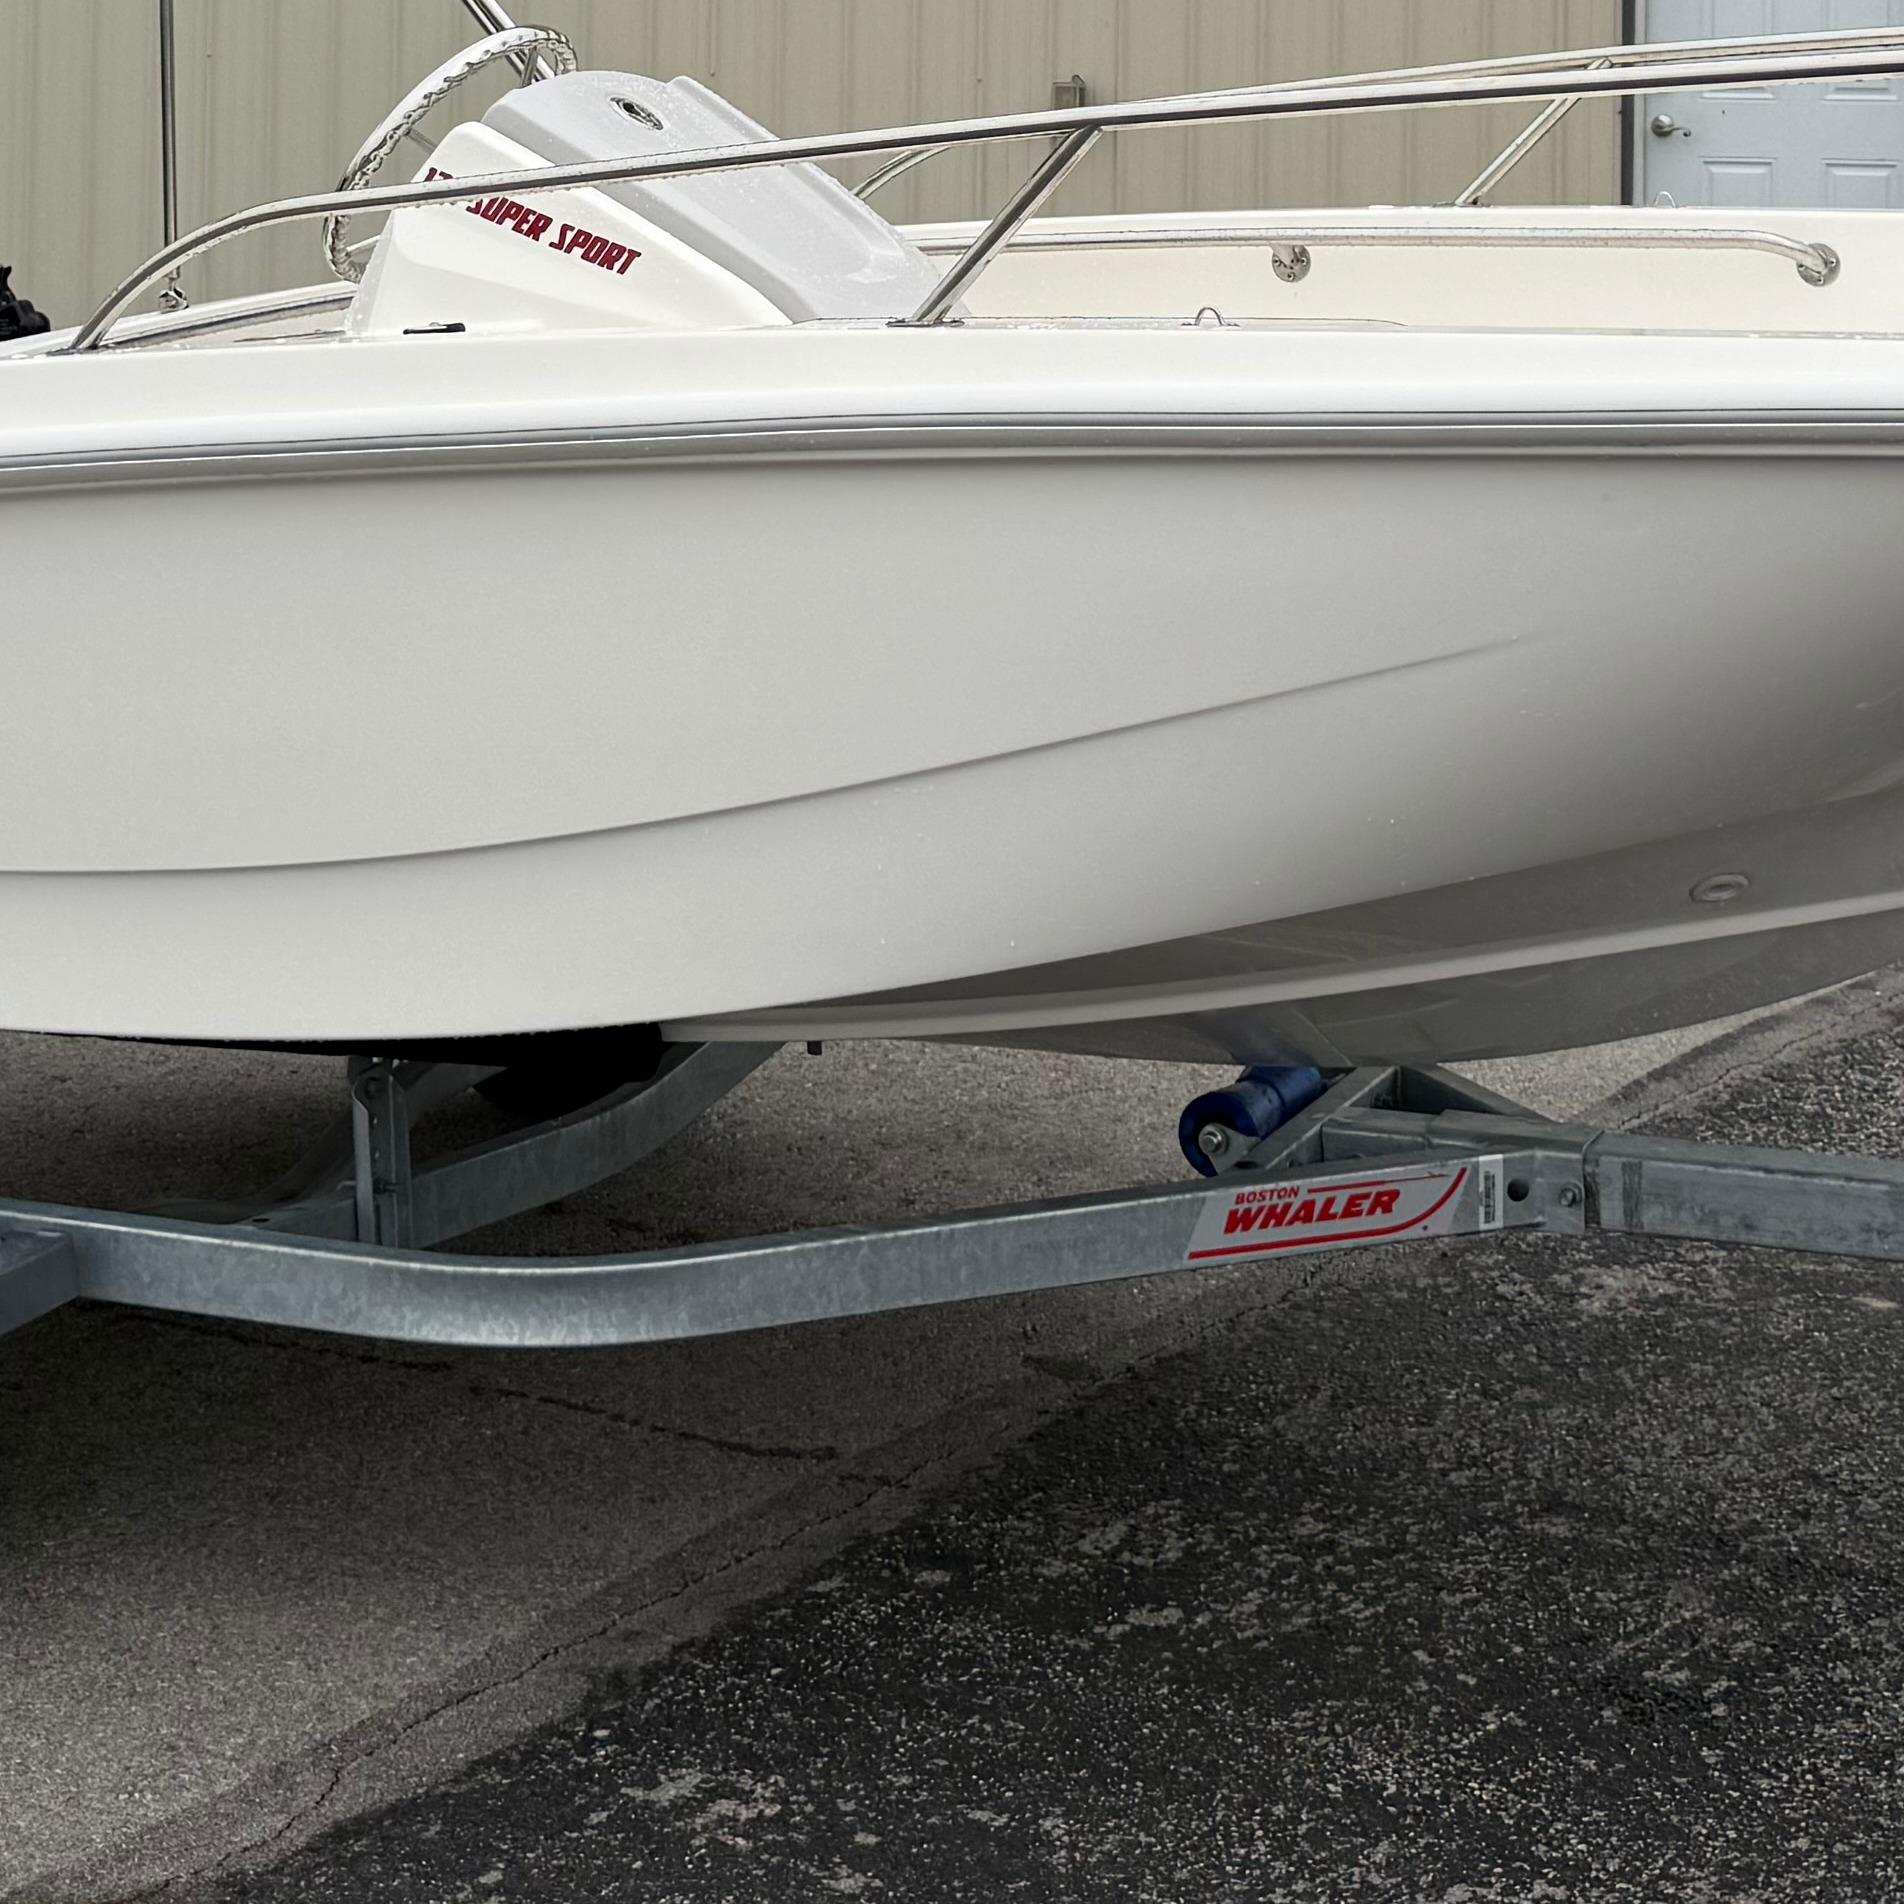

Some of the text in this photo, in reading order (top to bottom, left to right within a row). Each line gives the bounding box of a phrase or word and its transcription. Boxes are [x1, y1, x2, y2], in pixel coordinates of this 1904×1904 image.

[465, 197, 641, 275] SUPER SPORT
[1224, 1189, 1400, 1235] WHALER
[1235, 1186, 1300, 1205] BOSTON
